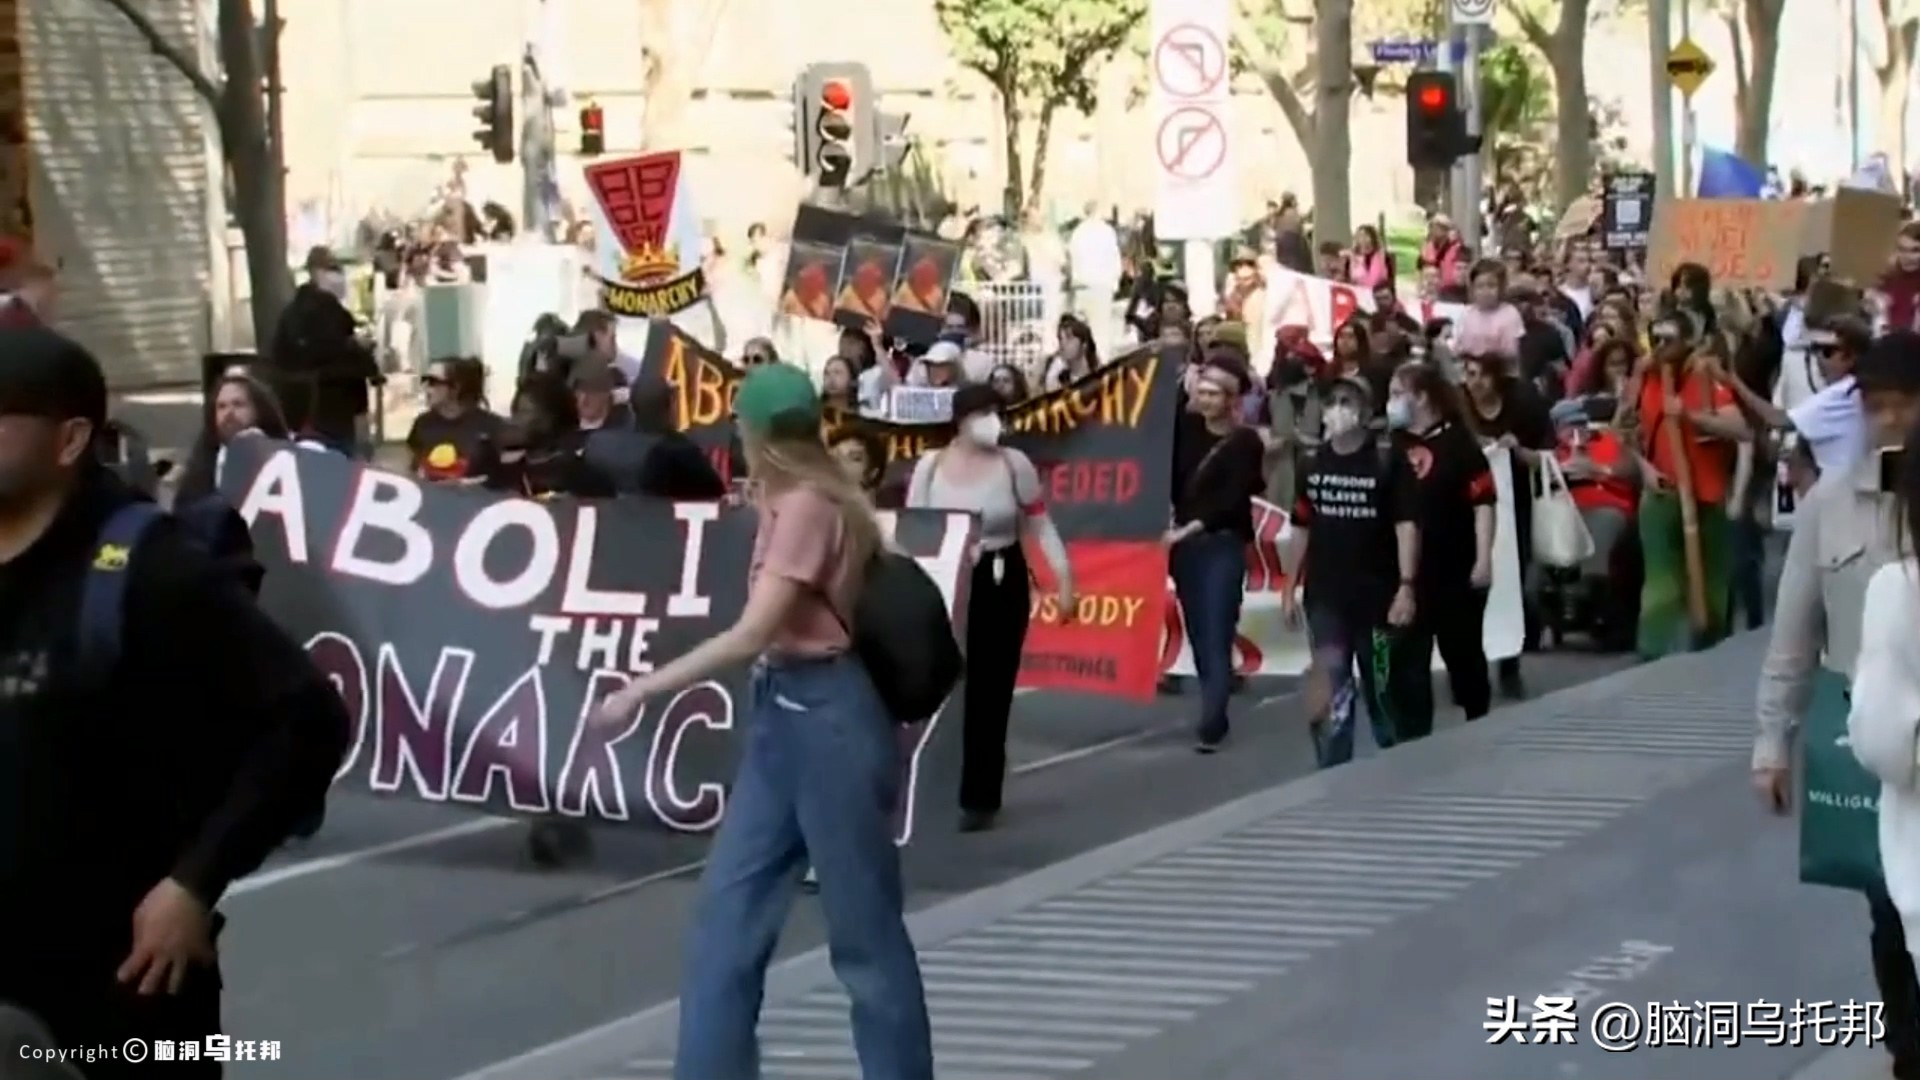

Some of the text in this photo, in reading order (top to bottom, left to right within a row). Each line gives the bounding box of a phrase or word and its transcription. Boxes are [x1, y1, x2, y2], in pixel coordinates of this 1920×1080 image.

[608, 279, 698, 315] MONARCHY
[241, 451, 973, 622] ABOLIH
[529, 614, 660, 674] THE
